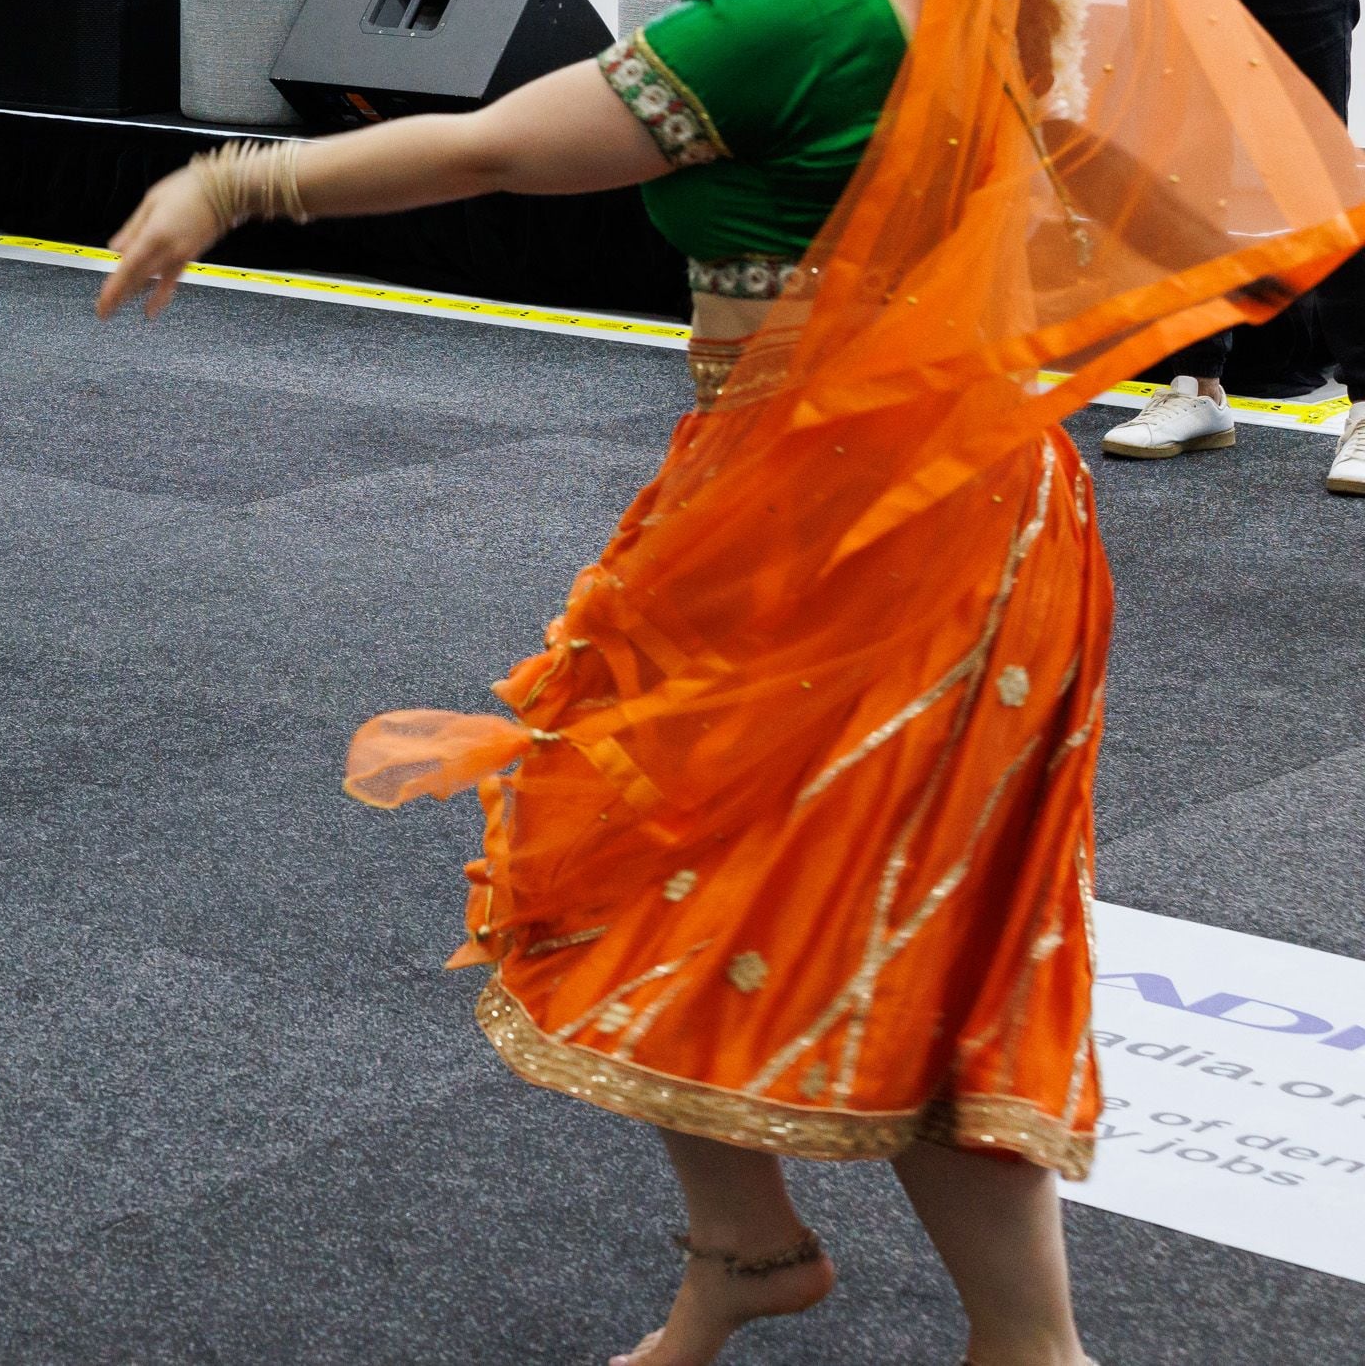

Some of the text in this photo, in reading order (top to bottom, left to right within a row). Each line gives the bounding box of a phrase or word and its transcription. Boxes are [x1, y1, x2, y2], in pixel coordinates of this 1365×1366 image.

[1092, 1029, 1365, 1119] adia.or
[1149, 1112, 1234, 1134] of
[1137, 1138, 1305, 1187] jobs
